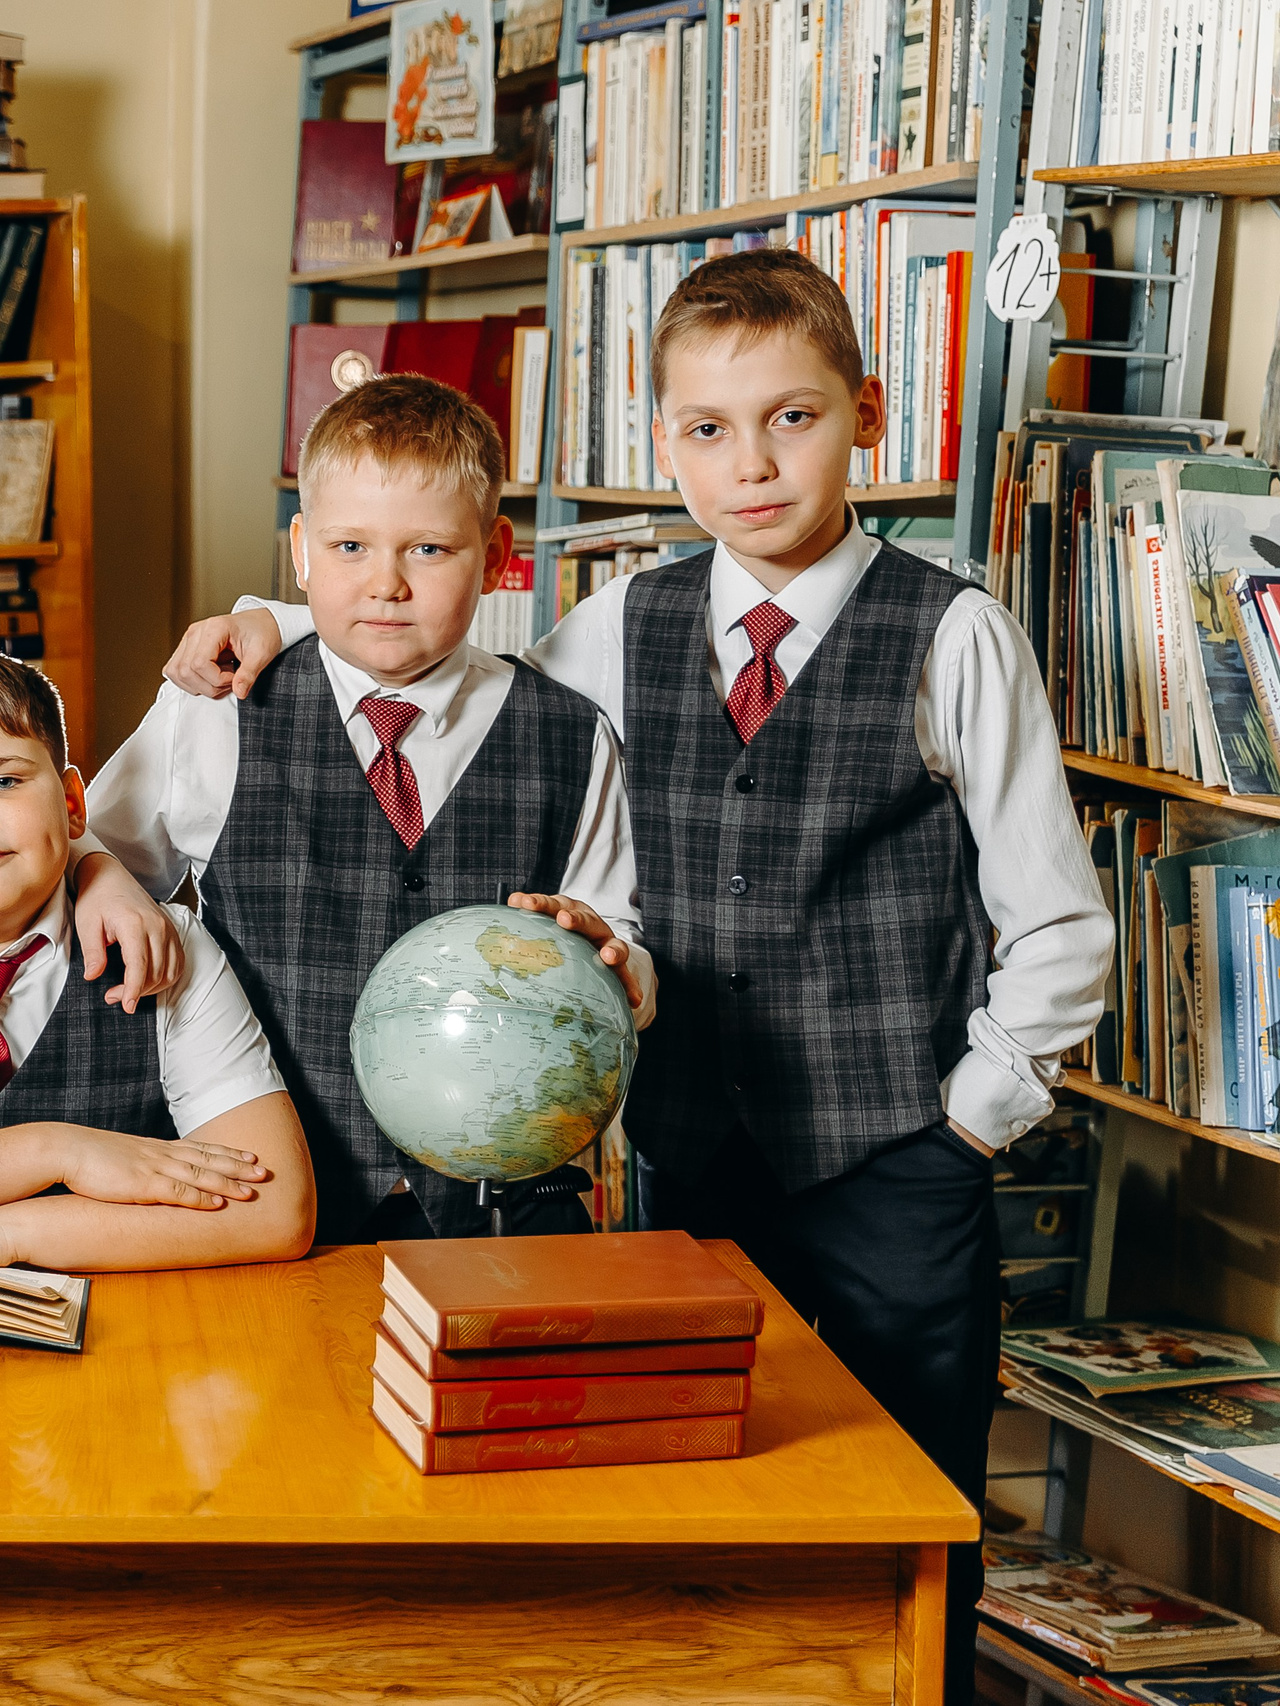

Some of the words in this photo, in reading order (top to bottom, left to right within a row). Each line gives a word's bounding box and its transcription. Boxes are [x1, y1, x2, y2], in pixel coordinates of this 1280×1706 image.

[996, 238, 1057, 309] 12+
[1157, 634, 1170, 710] ПРИКЛЮЧЕНИЯ
[1235, 971, 1245, 1052] ЛИТЕРАТУРЫ
